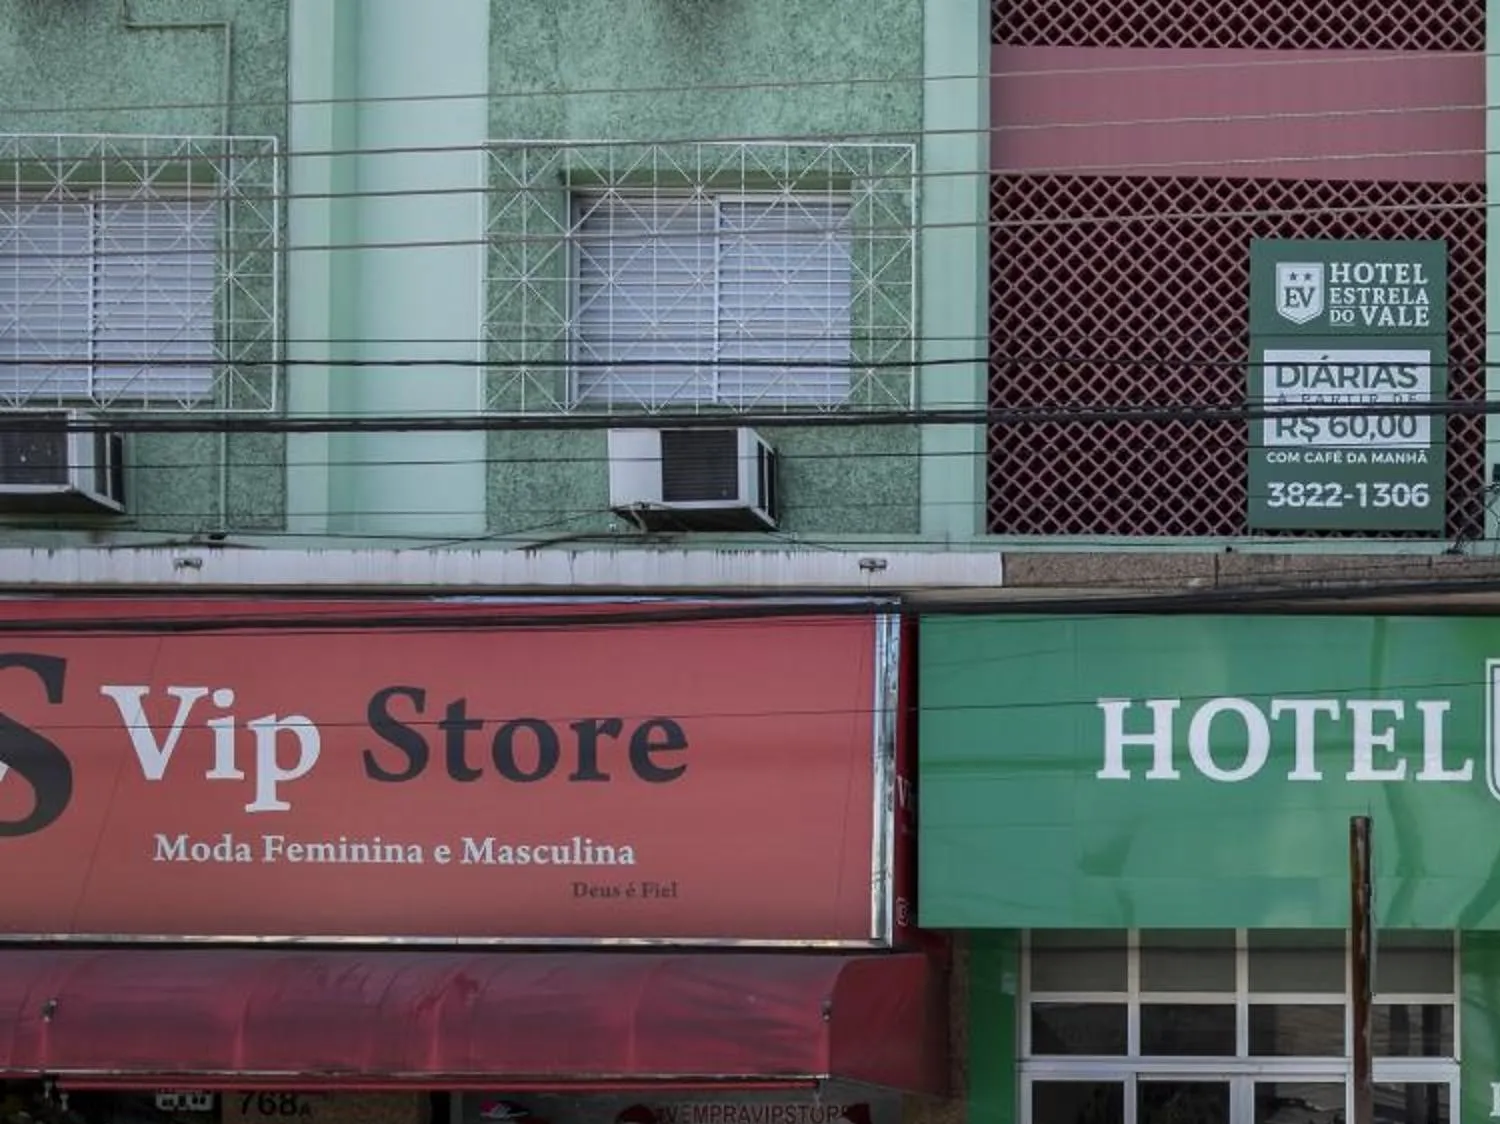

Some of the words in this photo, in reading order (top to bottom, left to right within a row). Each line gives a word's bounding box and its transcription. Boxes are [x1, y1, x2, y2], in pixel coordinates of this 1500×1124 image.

[1329, 262, 1428, 285] HOTEL
[1329, 287, 1430, 306] ESTRELA
[1329, 308, 1355, 324] DO
[1359, 306, 1431, 327] VALE
[1275, 355, 1419, 389] DIÁRIAS
[1328, 412, 1417, 441] 60,00
[1266, 451, 1301, 464] COM
[1304, 448, 1343, 464] CAFÉ
[1347, 451, 1368, 464] DA
[1371, 449, 1428, 464] MANHÃ
[1266, 482, 1430, 509] 3822-1306
[100, 684, 322, 814] Vip
[362, 686, 690, 784] Store
[1096, 696, 1474, 782] HOTEL
[153, 833, 253, 864] Moda
[262, 835, 424, 865] Feminina
[433, 845, 452, 865] e
[460, 837, 637, 866] Masculina
[571, 880, 622, 899] Deus
[625, 880, 637, 899] é
[640, 880, 680, 899] Fiel
